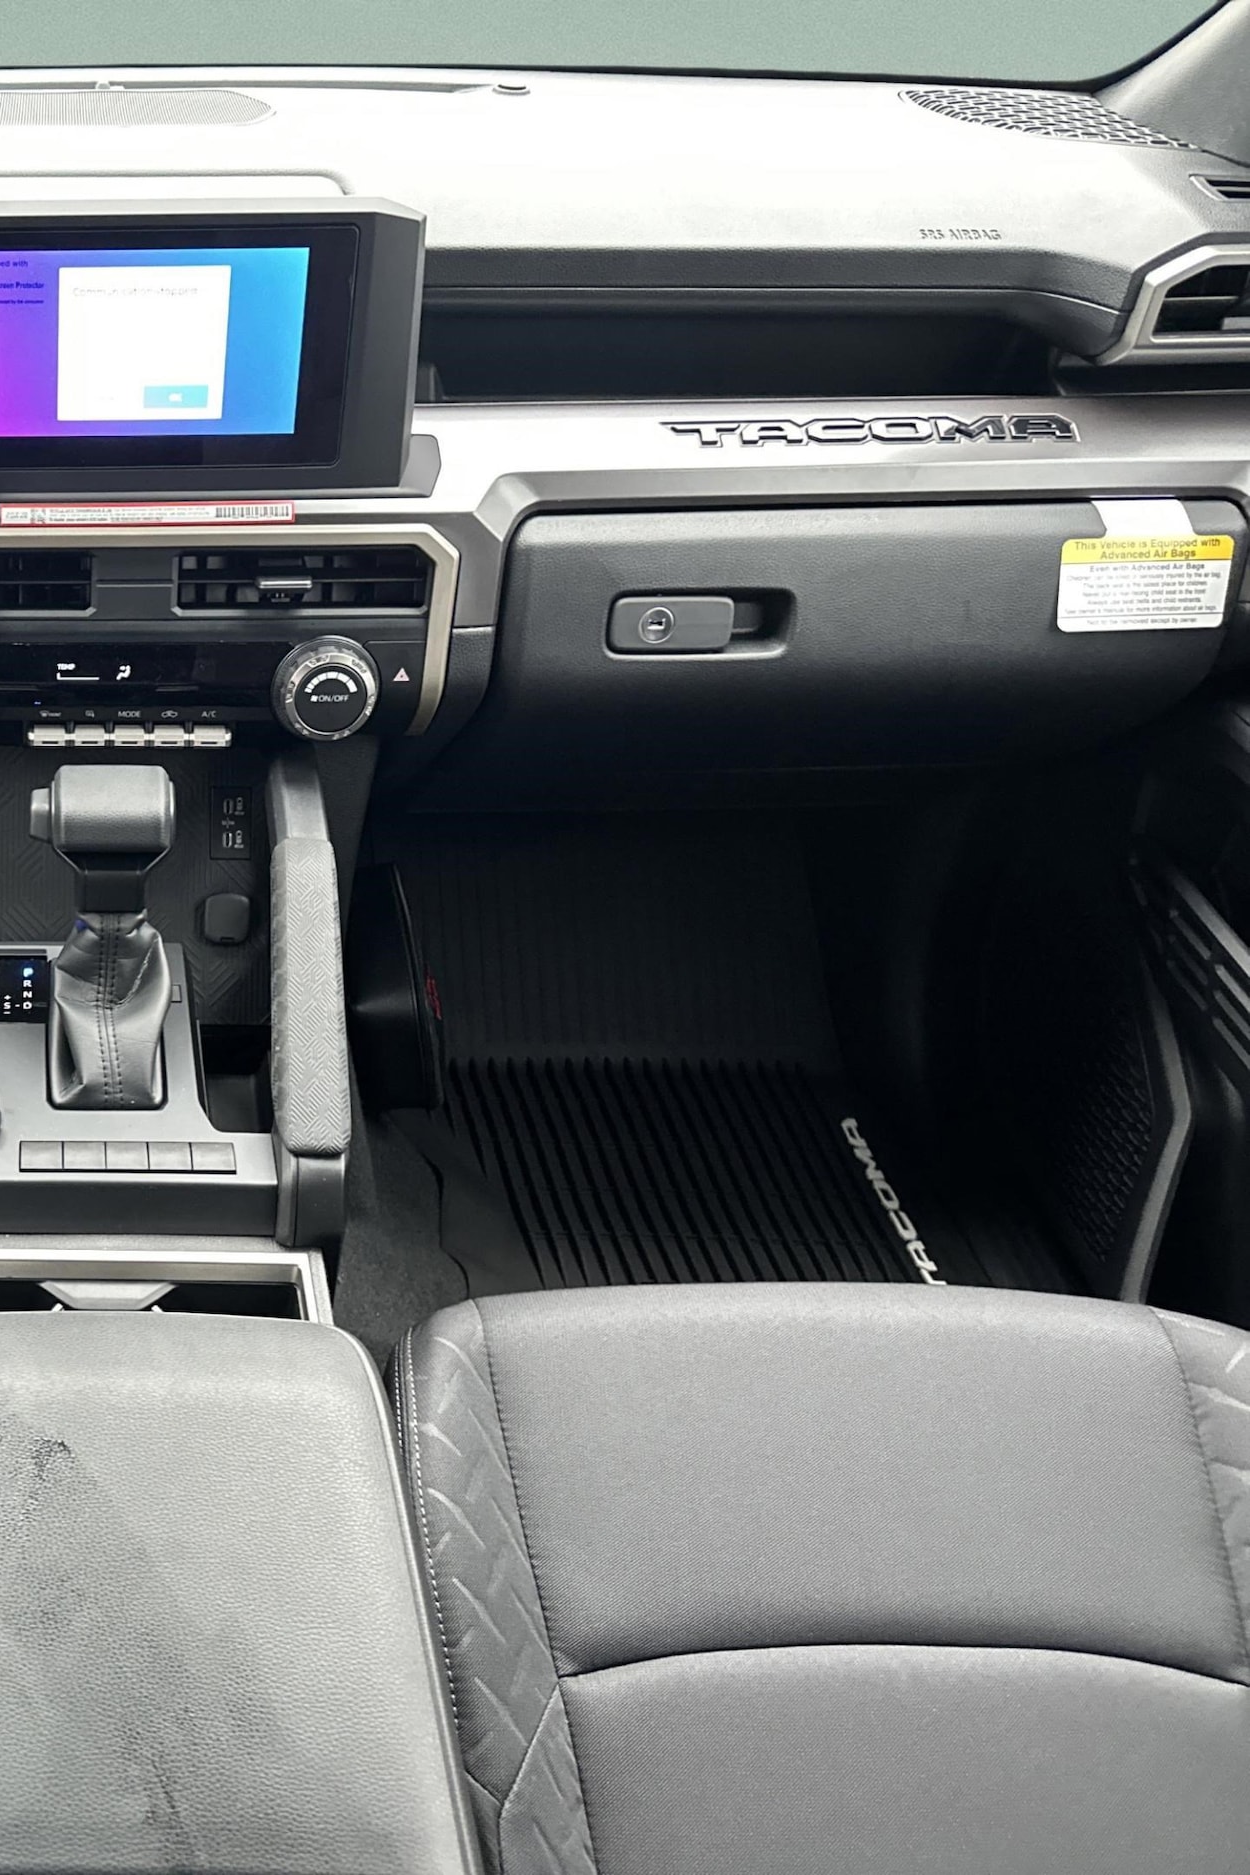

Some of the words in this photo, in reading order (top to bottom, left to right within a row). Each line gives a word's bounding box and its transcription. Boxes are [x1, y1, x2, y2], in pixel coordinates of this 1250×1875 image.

[657, 413, 1081, 448] TACOMA
[1075, 541, 1097, 550] This
[1100, 540, 1135, 550] Vehicle
[1139, 539, 1147, 548] is
[1150, 538, 1198, 550] Equipped
[1201, 538, 1221, 547] with
[1100, 550, 1151, 560] Advanced
[1154, 549, 1168, 558] Air
[1171, 549, 1196, 560] Bags
[318, 694, 350, 703] ON/OFF
[117, 710, 142, 718] MODE
[201, 710, 217, 718] A/C
[22, 967, 34, 978] P
[22, 979, 32, 988] R
[22, 990, 33, 999] N
[3, 1001, 12, 1010] S
[22, 1001, 33, 1010] D
